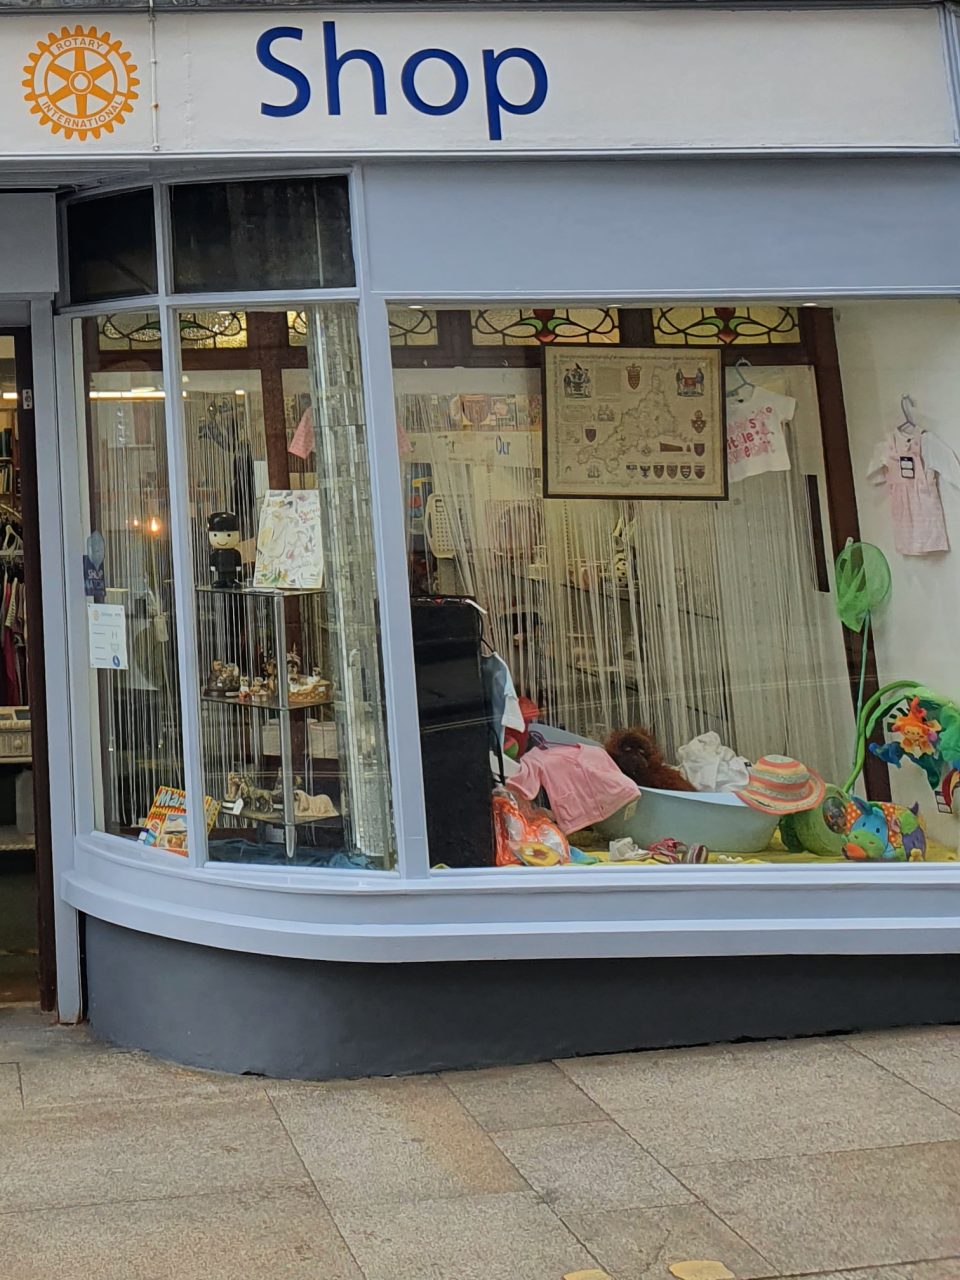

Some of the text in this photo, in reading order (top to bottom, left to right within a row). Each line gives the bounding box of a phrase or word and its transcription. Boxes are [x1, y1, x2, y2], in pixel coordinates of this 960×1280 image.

[55, 37, 103, 52] ROTARY
[257, 21, 549, 141] Shop
[41, 99, 123, 128] INTERNATIONAL
